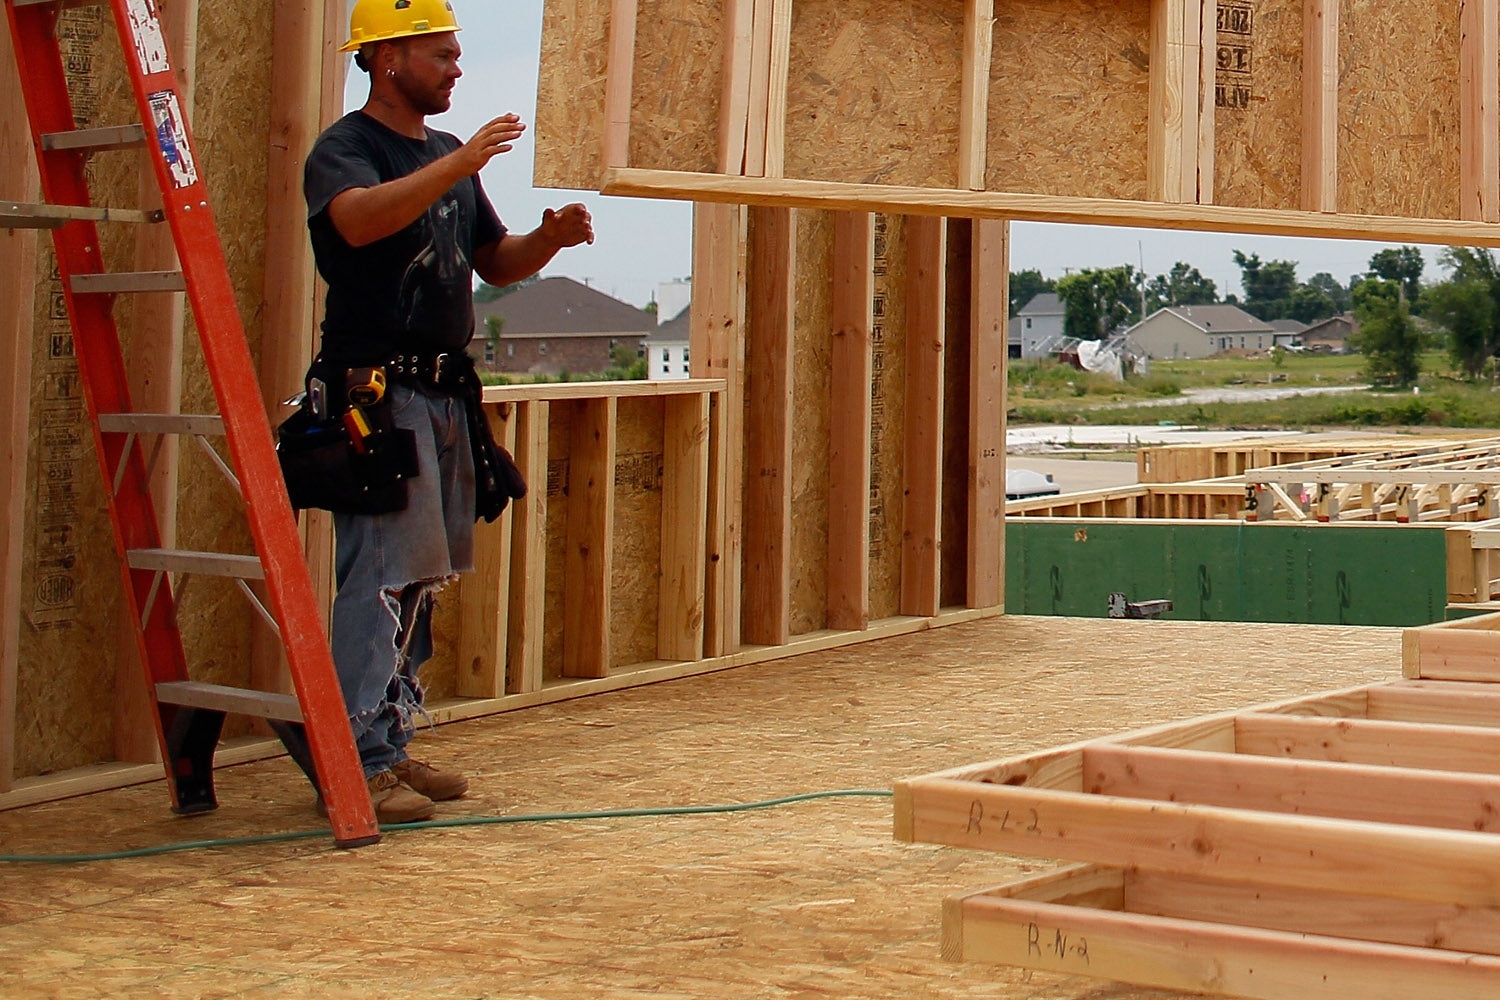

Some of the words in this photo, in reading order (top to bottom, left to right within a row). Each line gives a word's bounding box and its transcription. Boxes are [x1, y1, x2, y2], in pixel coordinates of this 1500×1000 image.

[1215, 9, 1249, 32] 2012
[1216, 48, 1248, 71] 16
[38, 576, 73, 603] HUBER
[1026, 922, 1091, 966] R-N-2
